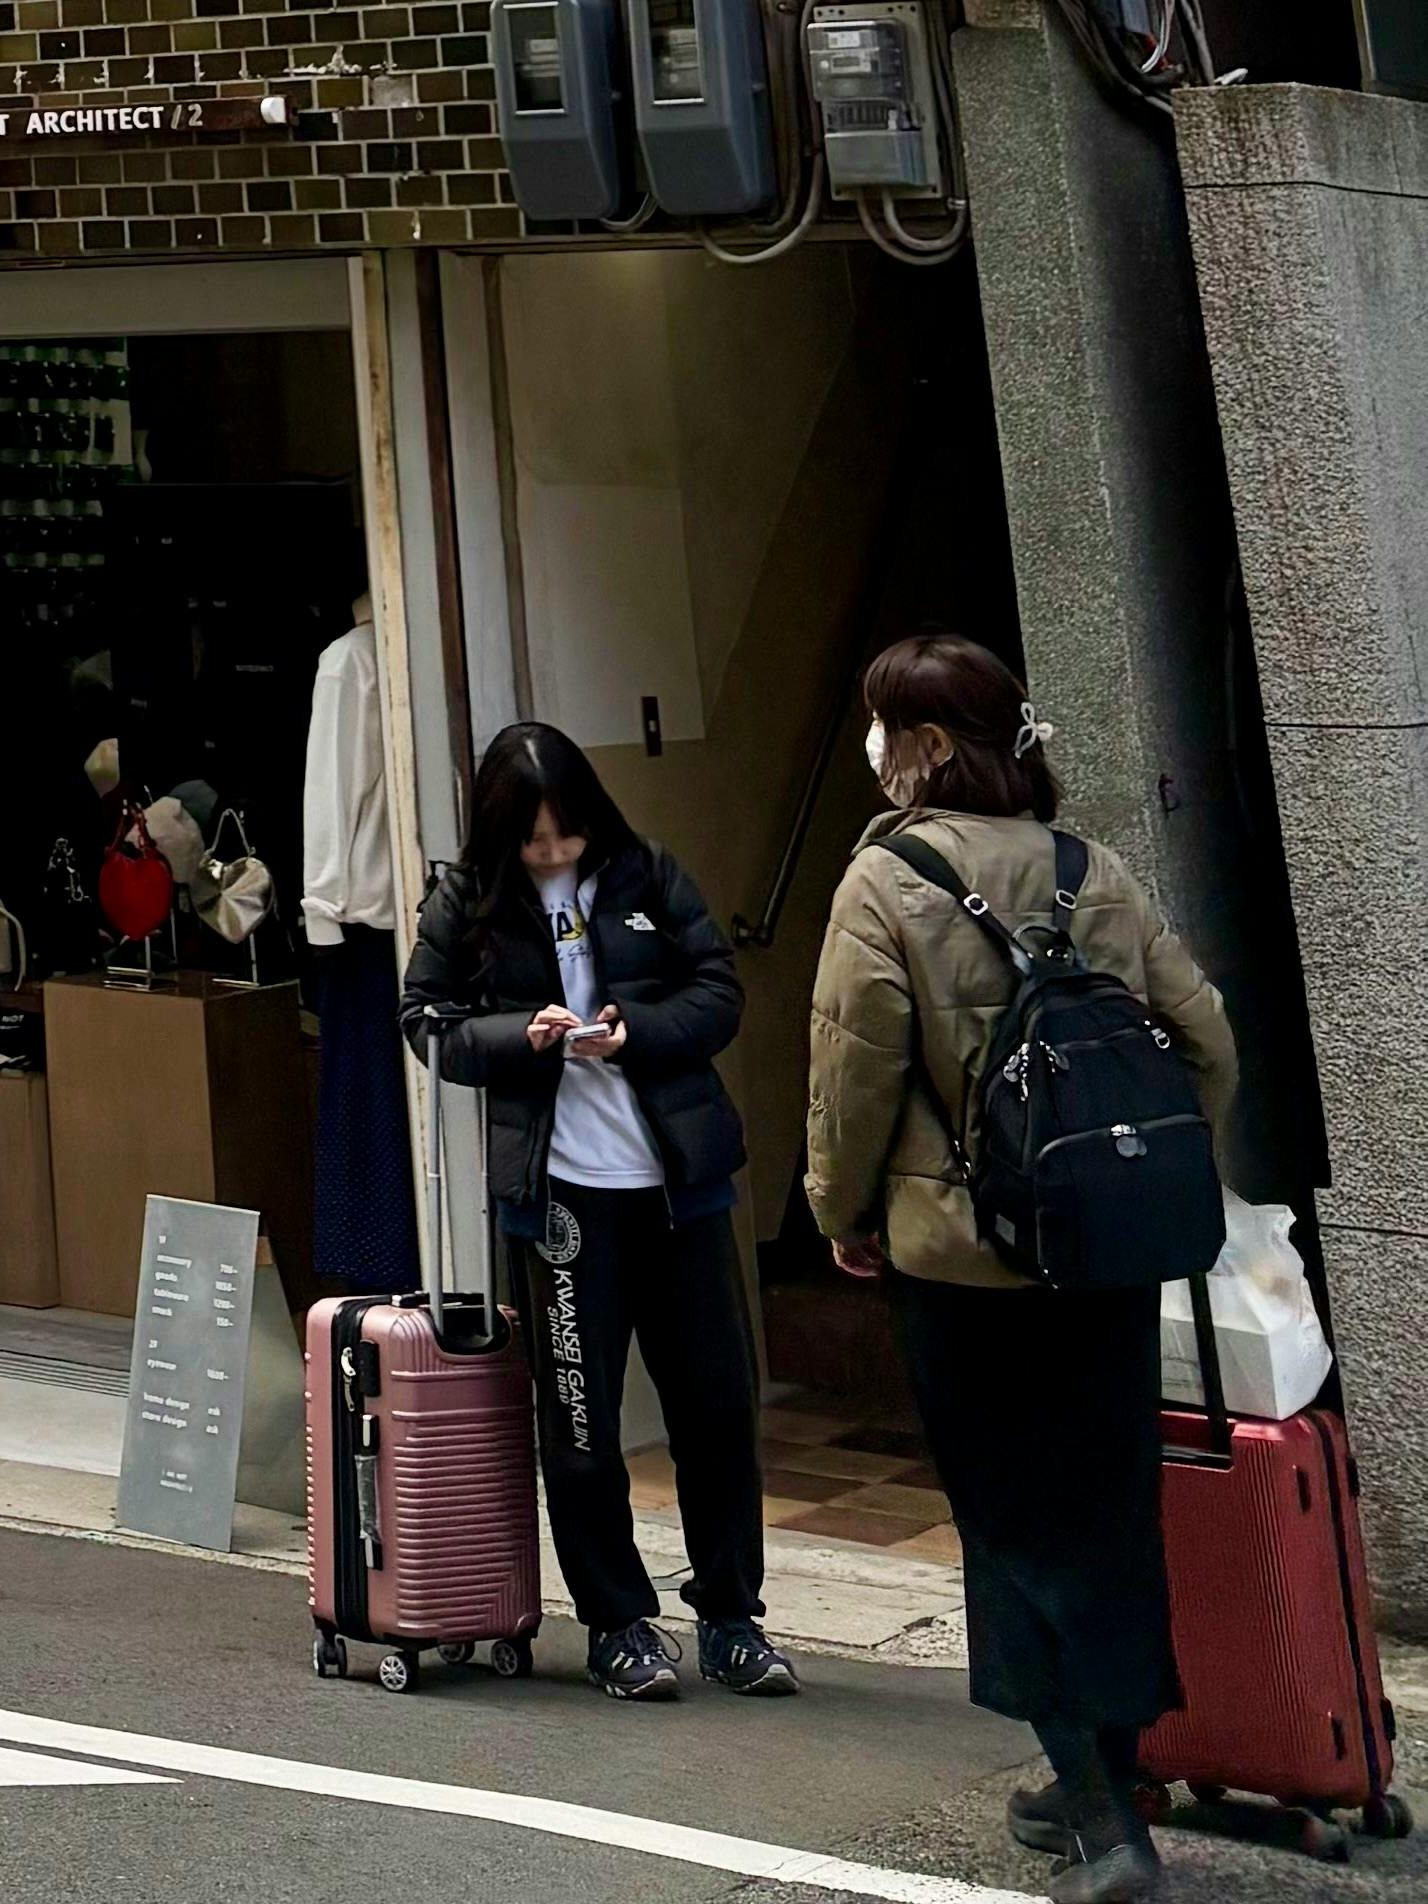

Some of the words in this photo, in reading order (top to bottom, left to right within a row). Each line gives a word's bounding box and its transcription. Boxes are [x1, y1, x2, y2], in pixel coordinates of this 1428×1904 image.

[26, 106, 164, 135] ARCHITECT
[187, 103, 203, 127] 2
[547, 1305, 565, 1361] SINCE
[567, 1368, 591, 1452] GAKUIN
